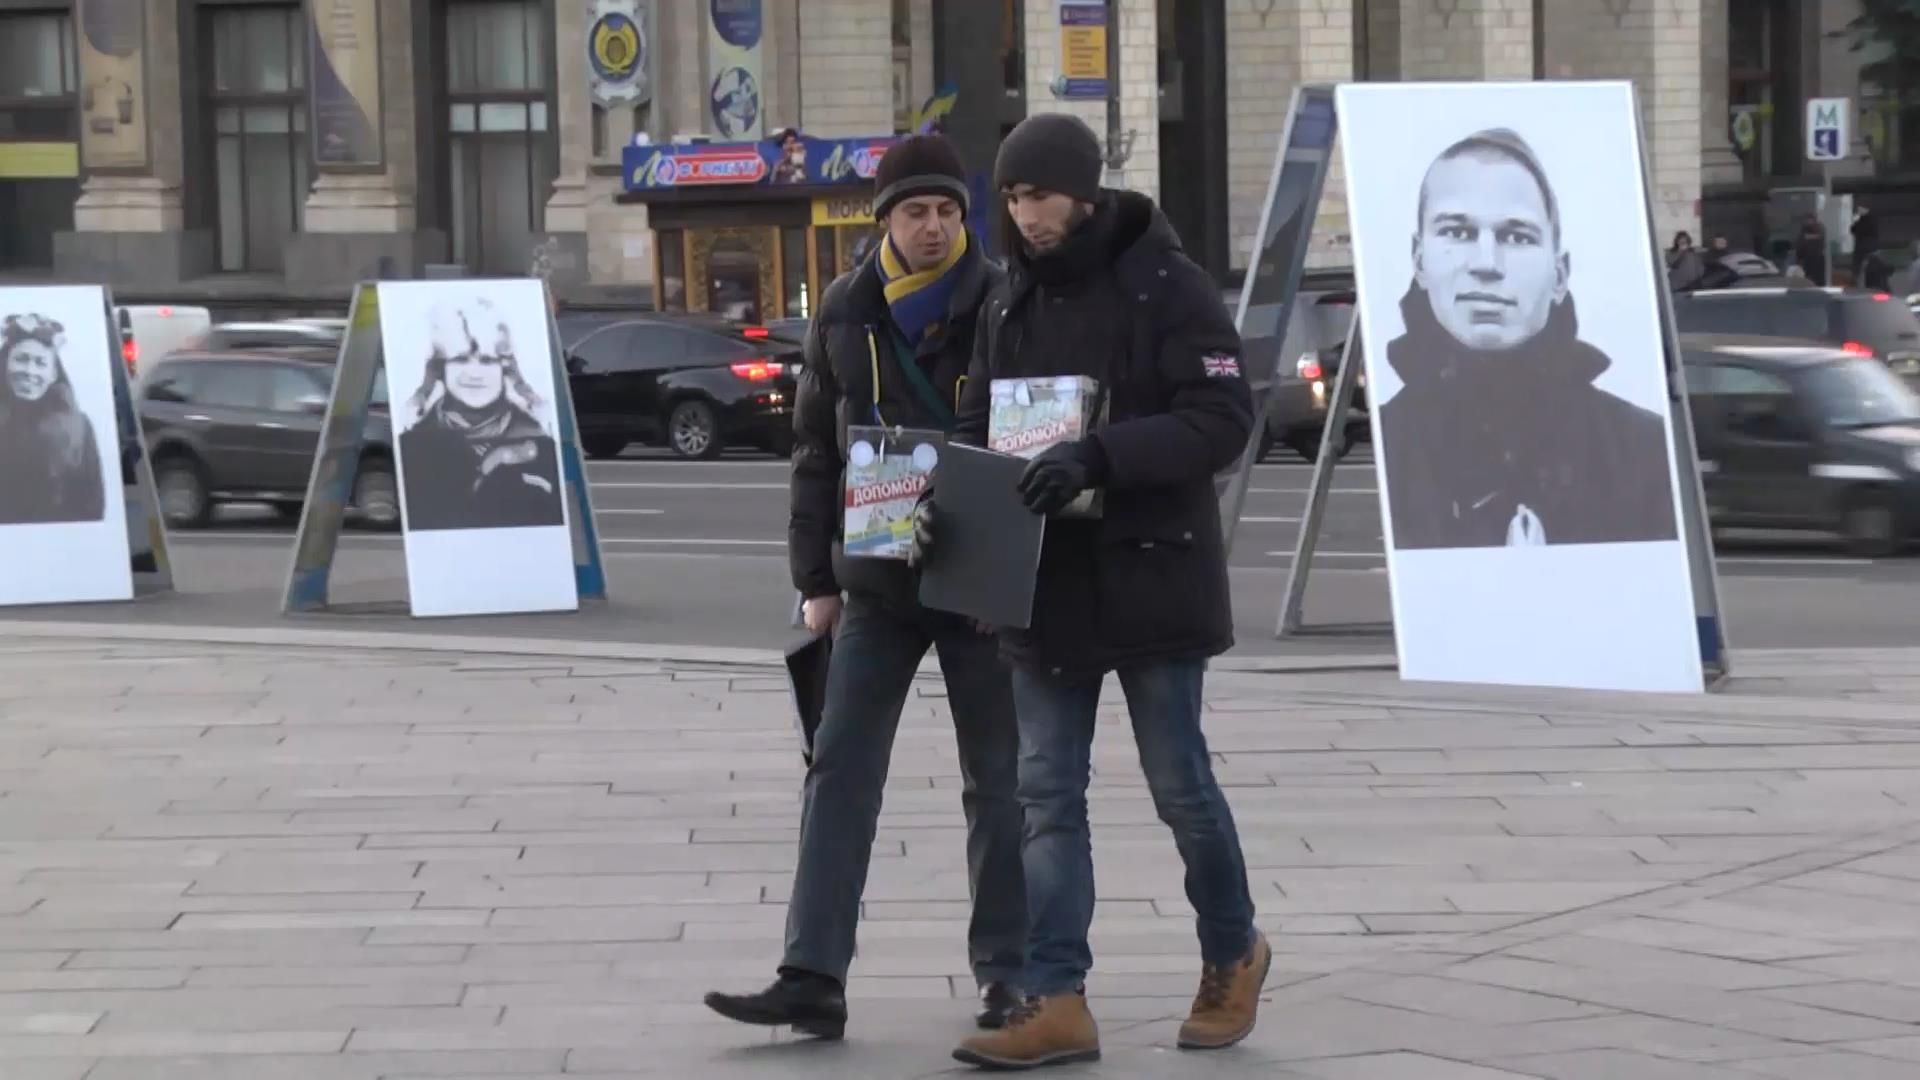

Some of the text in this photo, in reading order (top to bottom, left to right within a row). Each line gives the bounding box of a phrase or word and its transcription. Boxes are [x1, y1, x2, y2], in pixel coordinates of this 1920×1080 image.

[1816, 103, 1838, 126] М
[827, 200, 873, 219] МОРО
[996, 421, 1067, 452] ДОПОМОГА
[853, 475, 927, 507] ДОПОМОГА
